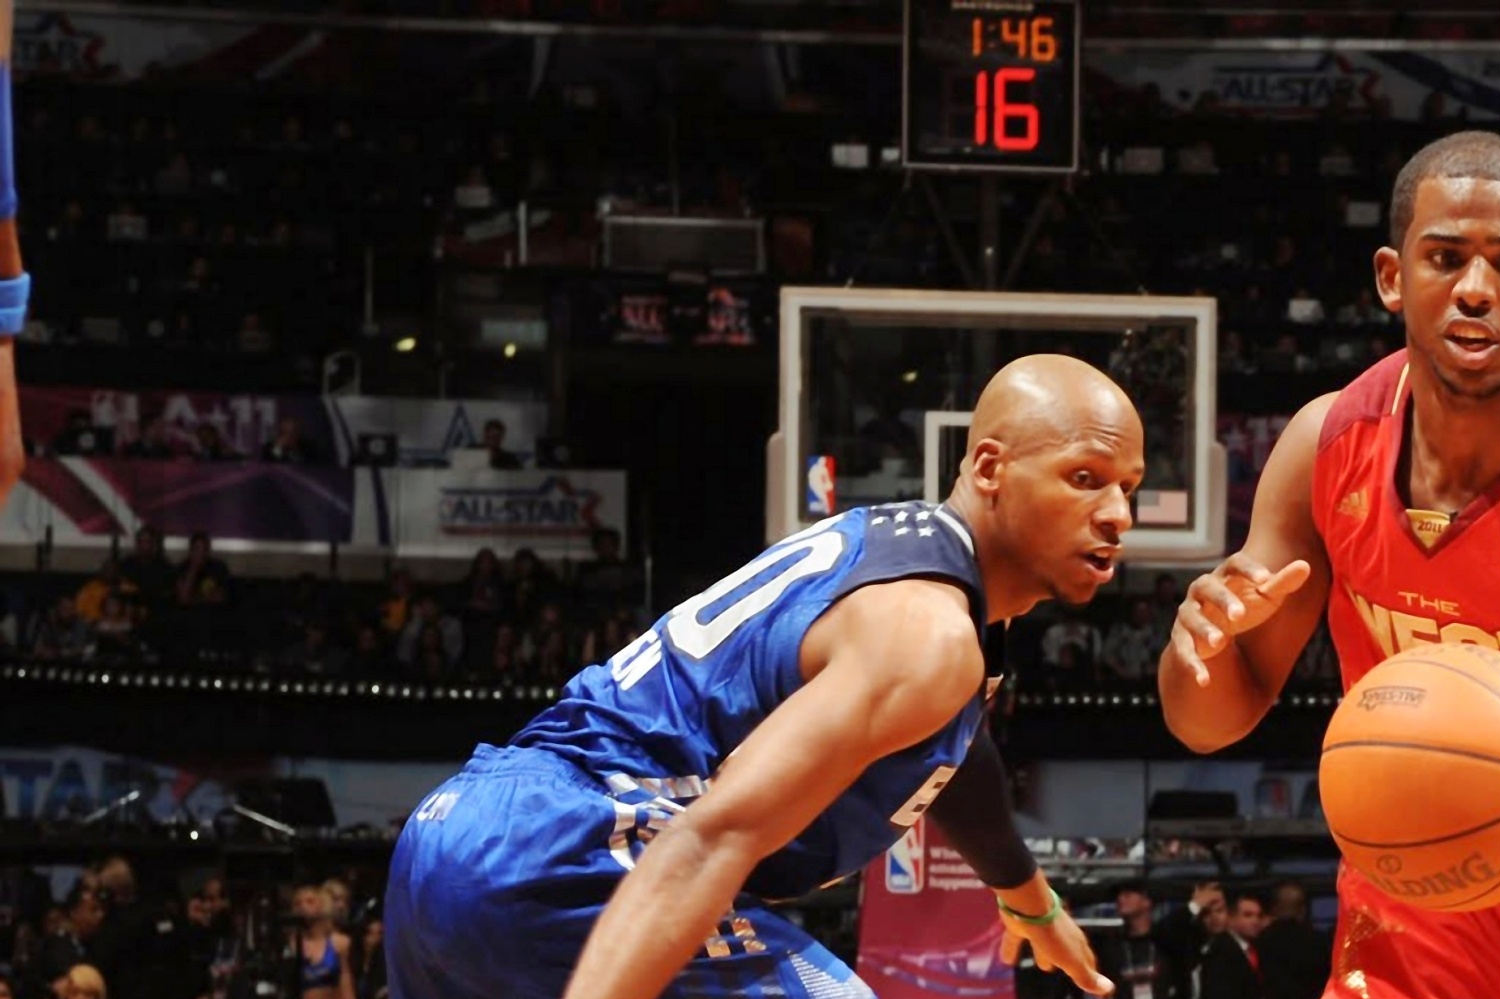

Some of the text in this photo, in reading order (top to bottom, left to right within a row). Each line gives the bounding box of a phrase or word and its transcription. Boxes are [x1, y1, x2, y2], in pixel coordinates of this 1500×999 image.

[972, 16, 1057, 62] 1:46
[974, 67, 1040, 151] 16
[453, 499, 580, 523] ALL-STAR
[1418, 519, 1443, 533] 2011
[666, 521, 848, 660] 0
[1398, 590, 1460, 617] THE
[1368, 852, 1500, 897] LDING
